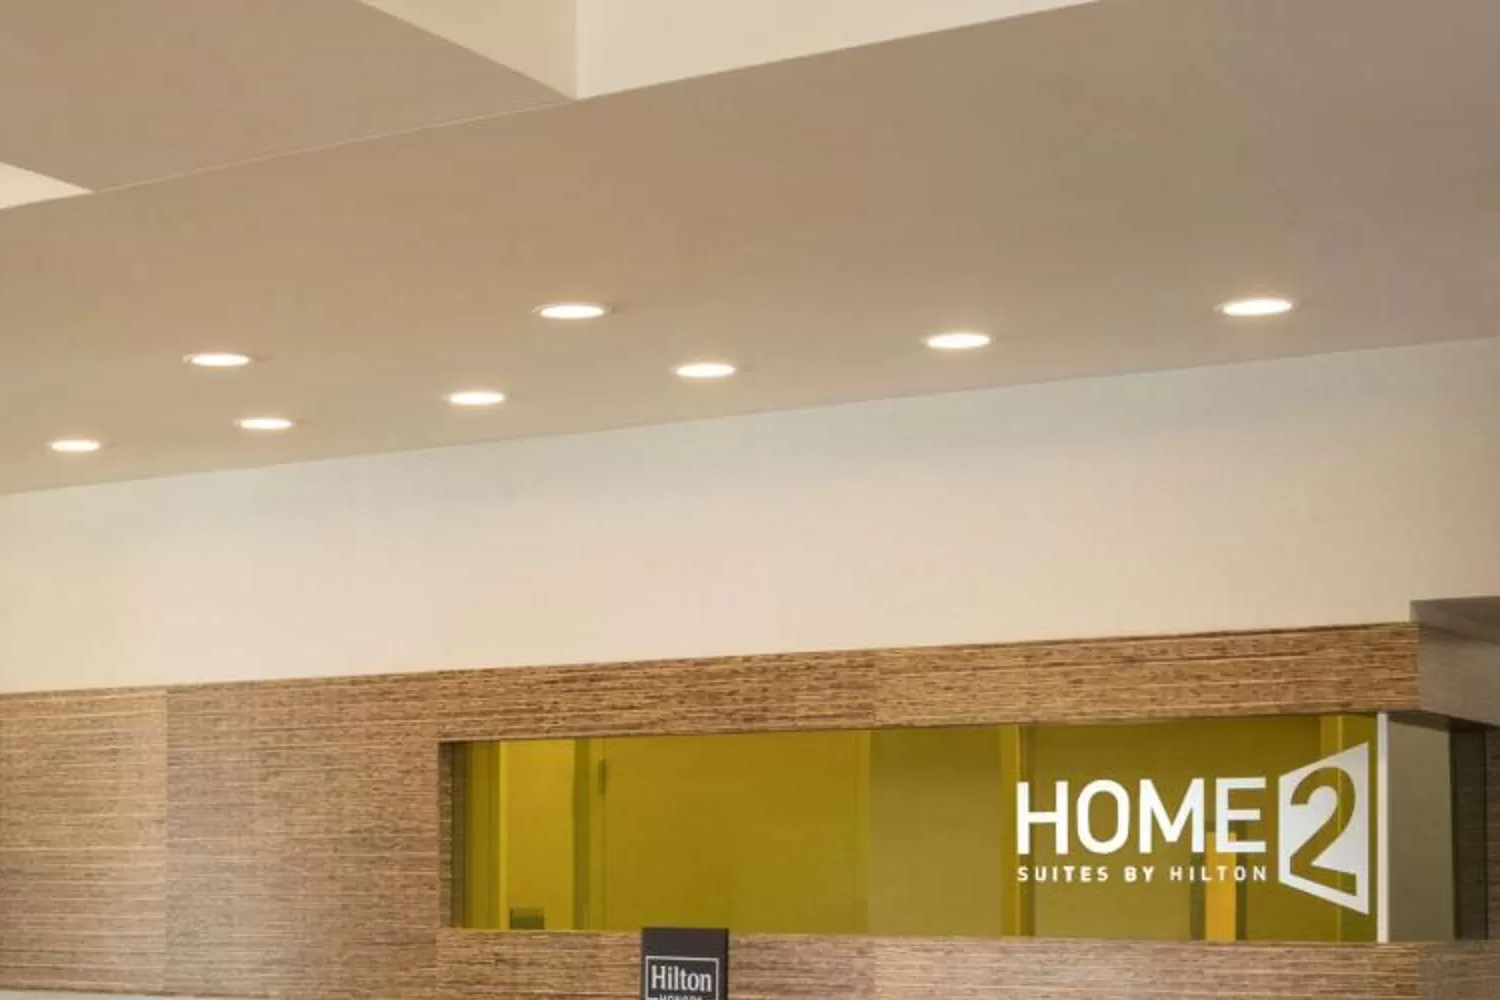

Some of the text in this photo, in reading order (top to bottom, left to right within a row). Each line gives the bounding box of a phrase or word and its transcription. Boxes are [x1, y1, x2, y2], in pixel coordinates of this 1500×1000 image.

[1016, 864, 1268, 883] SUITES BY HILTON
[651, 964, 712, 992] Hilton
